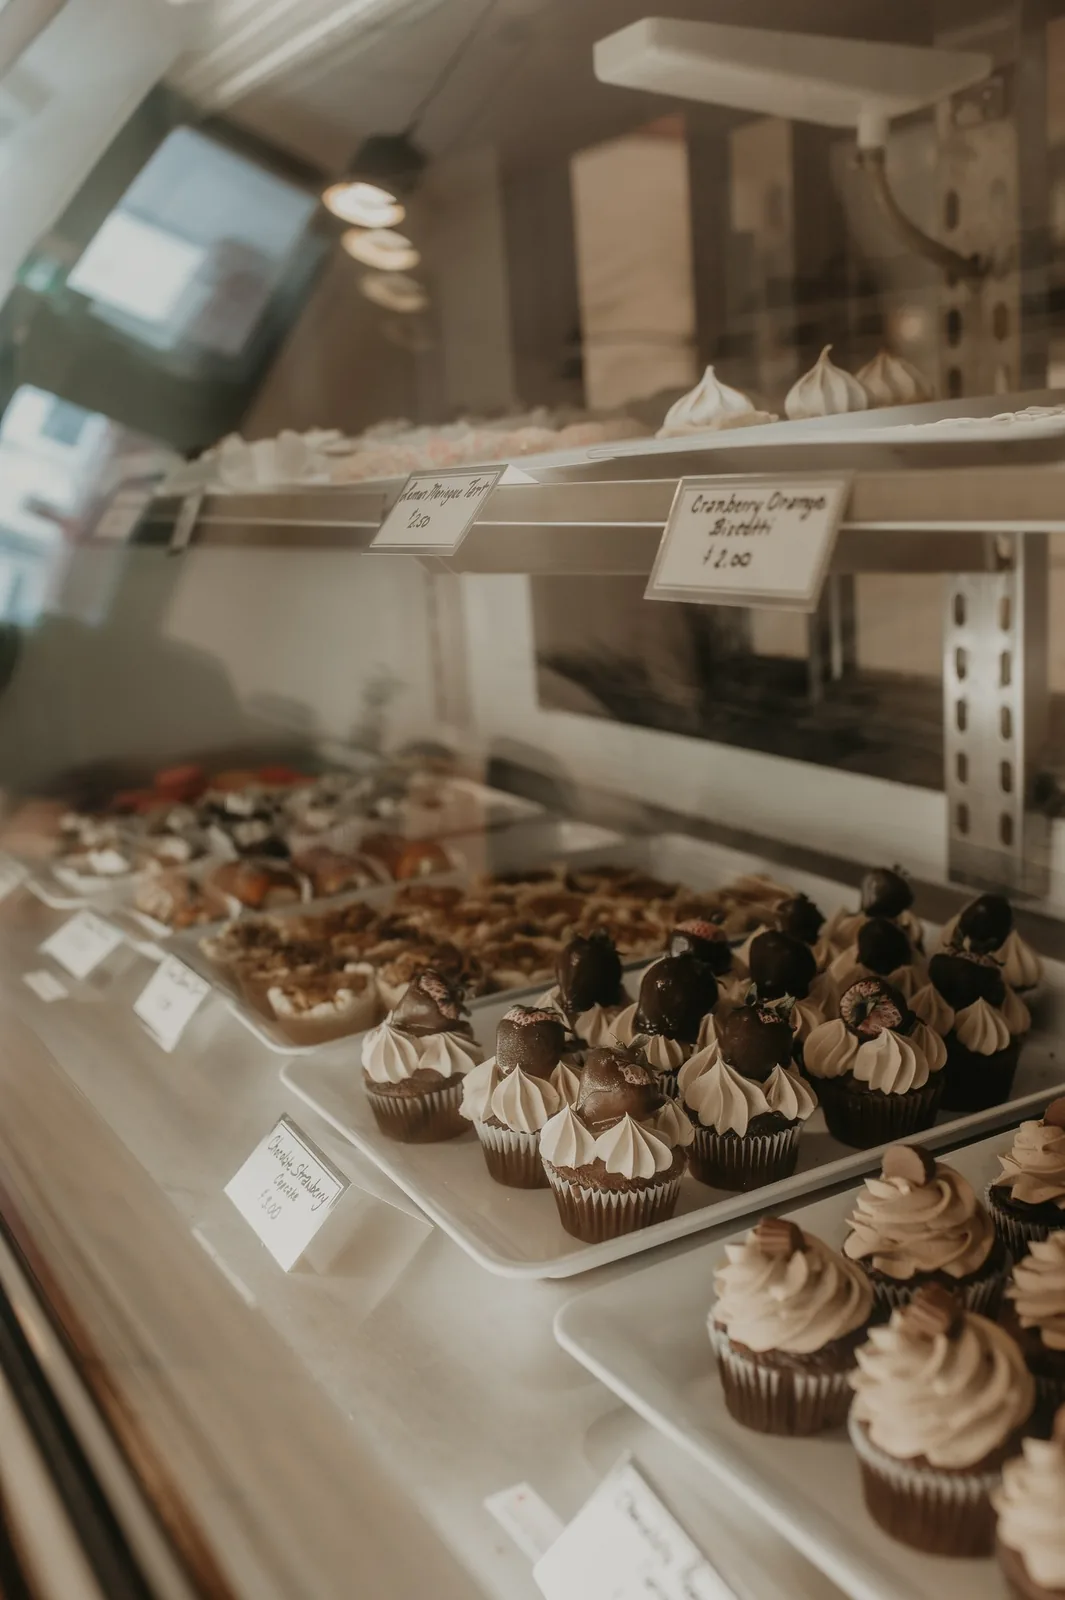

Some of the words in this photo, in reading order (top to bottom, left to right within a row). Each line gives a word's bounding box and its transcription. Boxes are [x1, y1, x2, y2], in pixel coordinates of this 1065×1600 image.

[399, 481, 428, 502] Lemon
[464, 477, 490, 499] Tart
[691, 493, 763, 524] Cranberry
[757, 491, 827, 521] Orange
[708, 517, 776, 537] Biscotti
[268, 1134, 293, 1172] Chocolate
[290, 1163, 330, 1212] Strawberry
[273, 1173, 300, 1202] Cupcake
